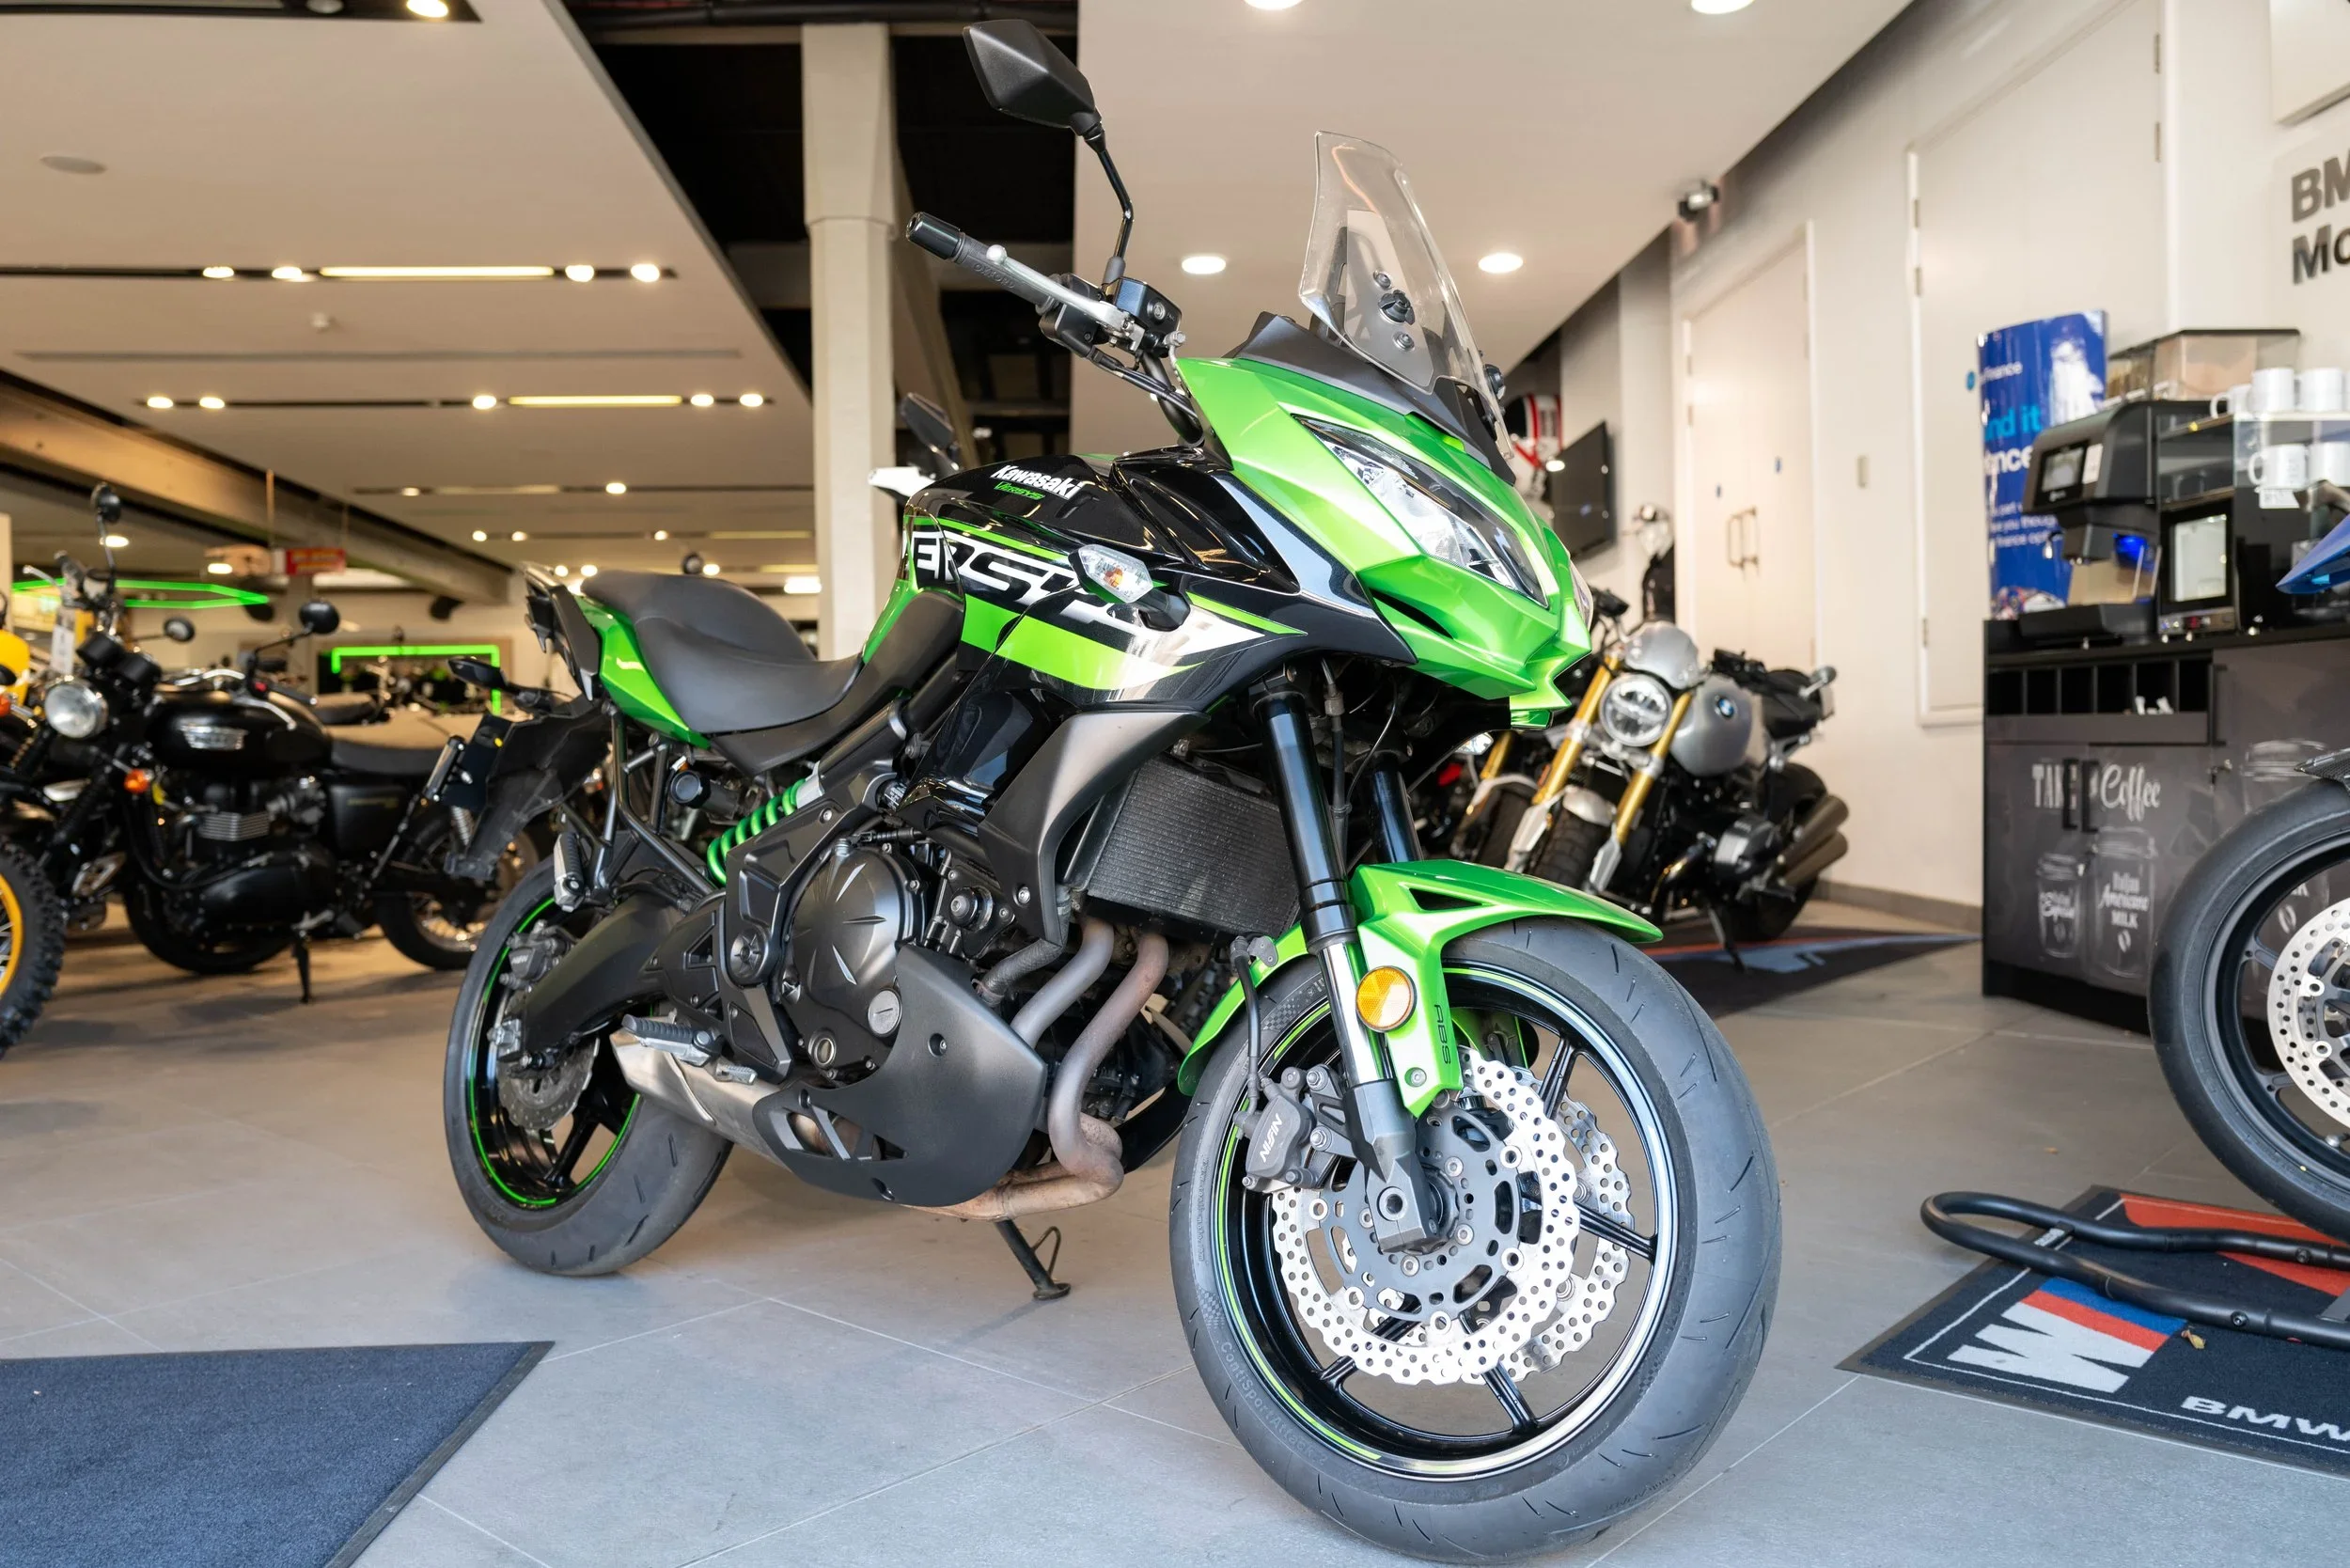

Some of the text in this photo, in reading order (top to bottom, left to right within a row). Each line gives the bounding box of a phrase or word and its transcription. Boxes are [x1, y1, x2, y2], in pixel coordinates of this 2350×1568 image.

[974, 263, 1015, 289] OXFORD
[2021, 405, 2043, 433] it
[990, 465, 1083, 500] Kawasaki
[2101, 763, 2161, 822] Coffee
[1434, 1004, 1451, 1064] ABS
[1260, 1112, 1282, 1163] NISSIN
[2181, 1395, 2350, 1442] BMW
